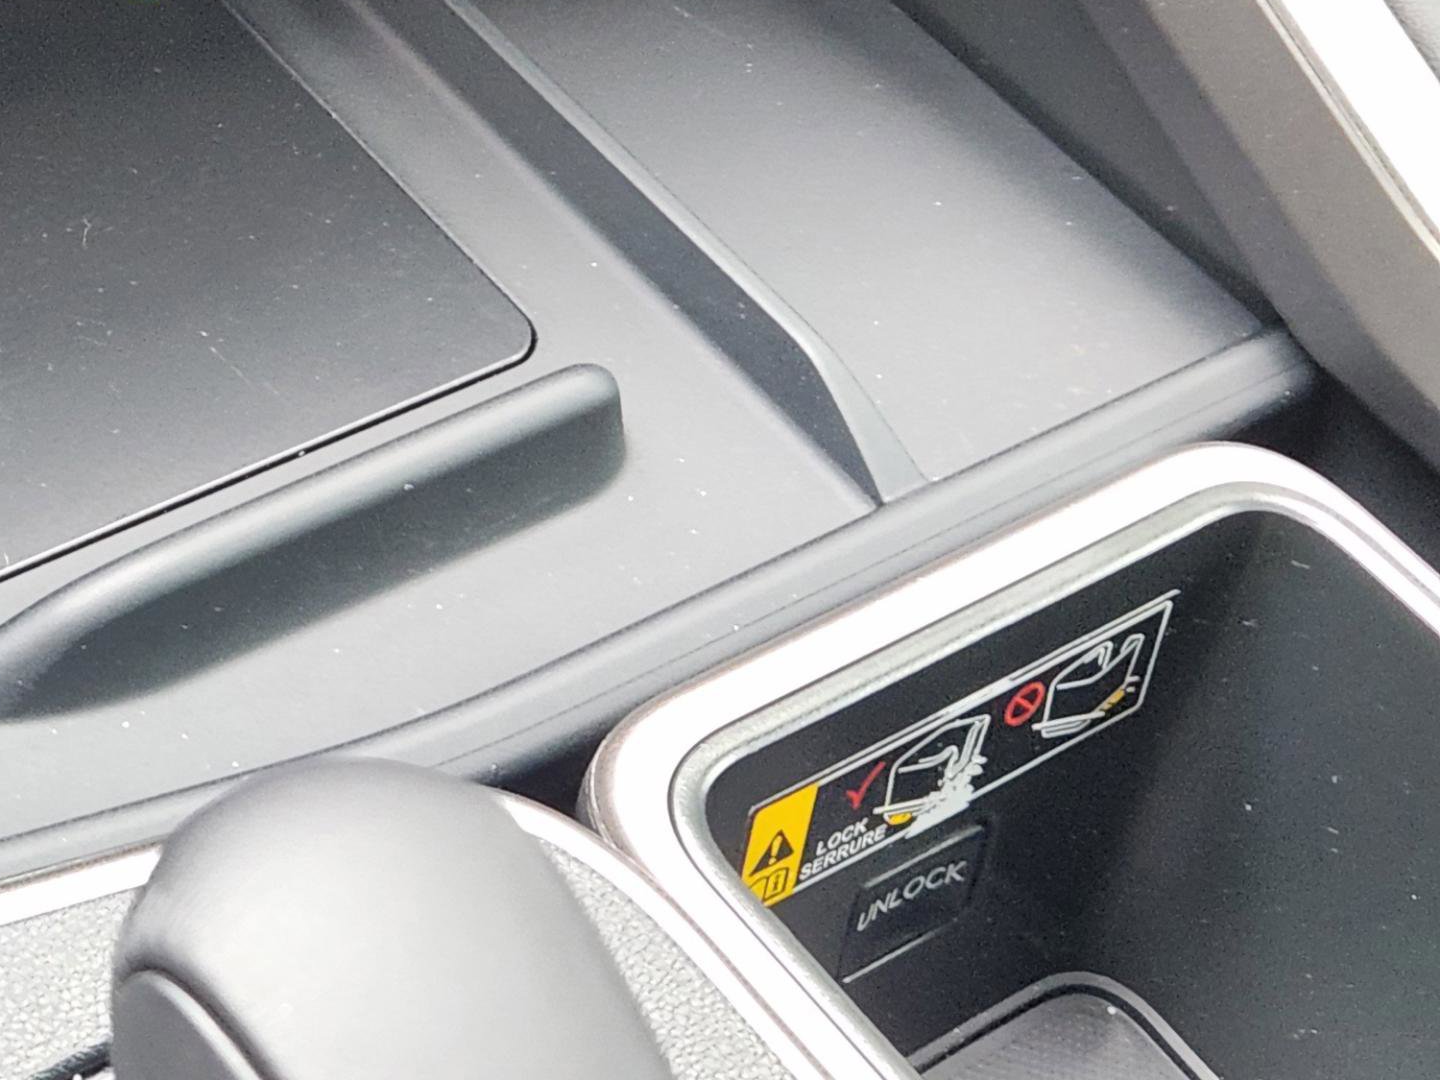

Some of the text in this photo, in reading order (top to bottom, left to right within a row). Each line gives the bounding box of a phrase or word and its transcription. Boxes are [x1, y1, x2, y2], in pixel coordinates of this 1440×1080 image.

[799, 824, 887, 880] SERRURE
[816, 817, 869, 855] LOCK
[857, 861, 967, 931] UNLOCK
